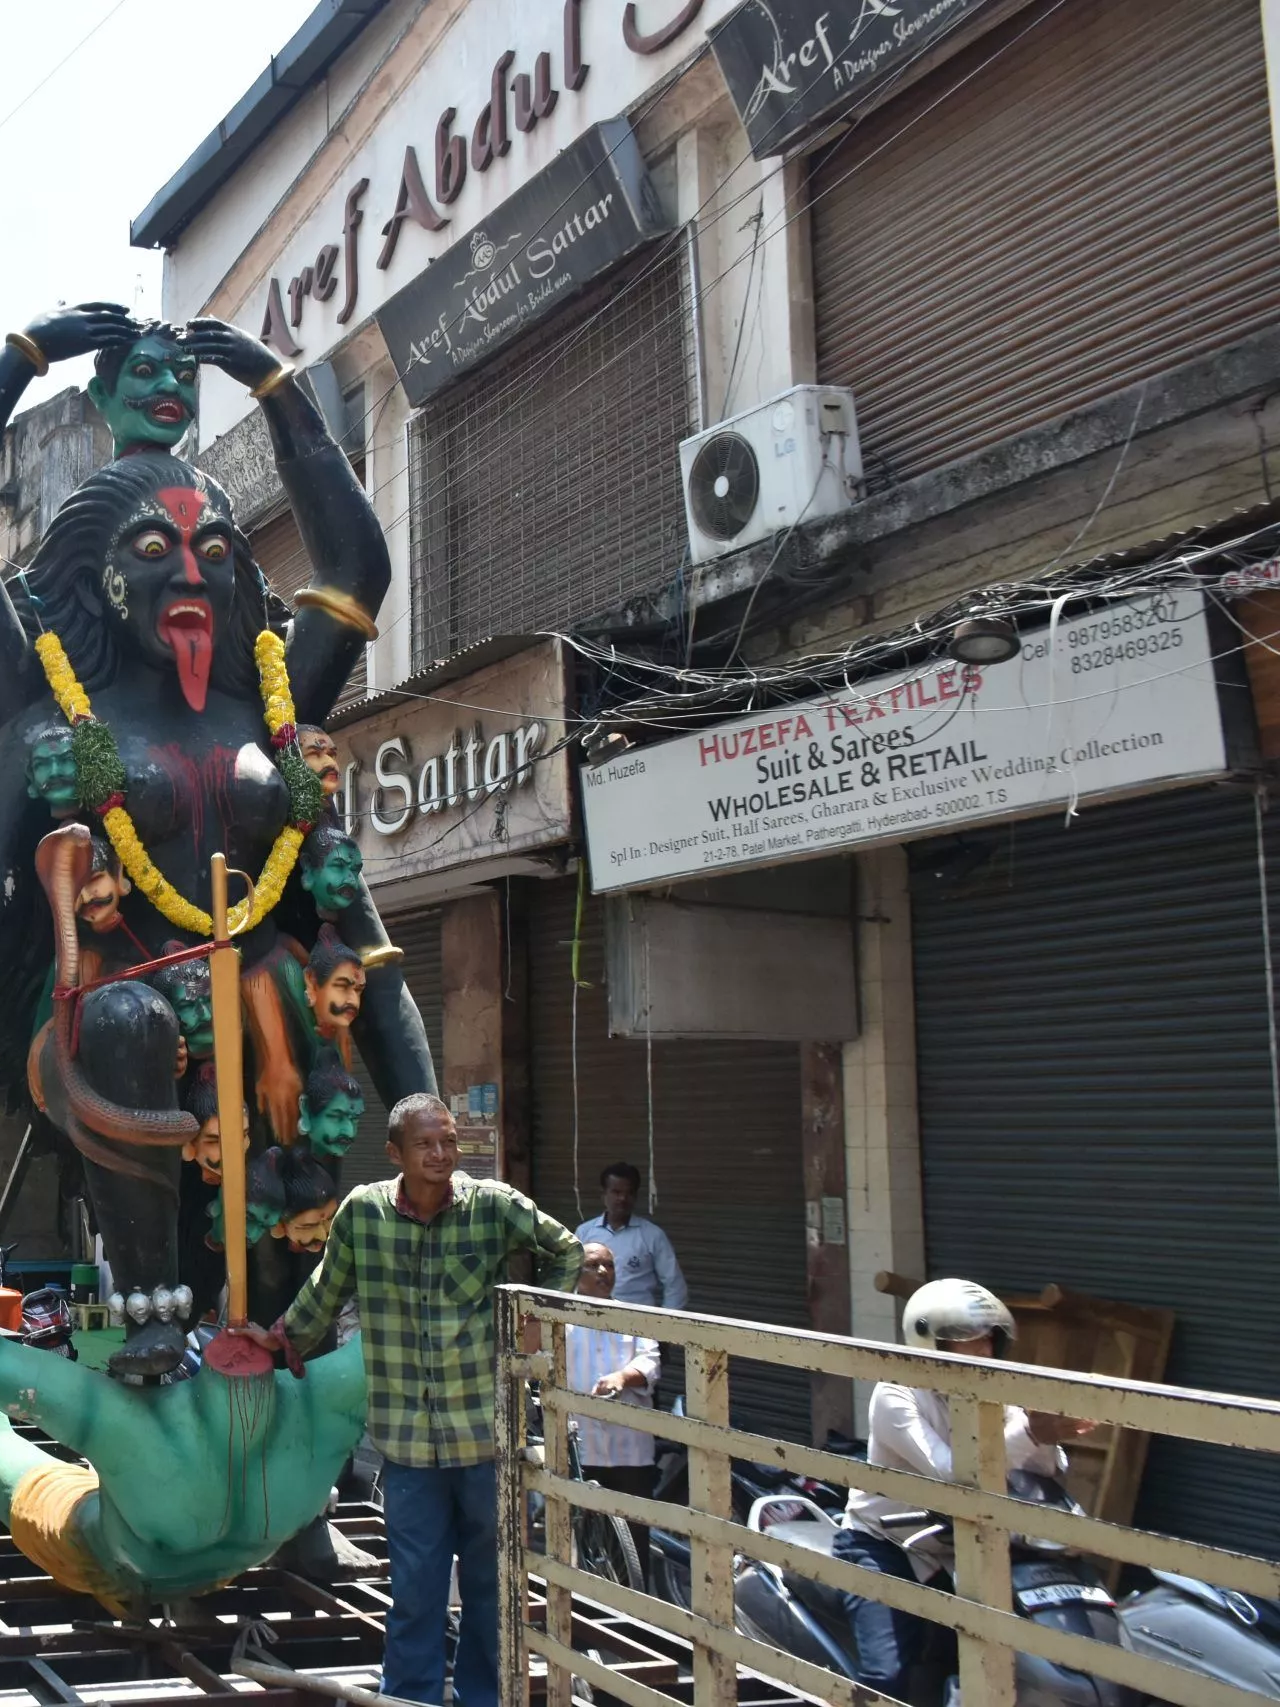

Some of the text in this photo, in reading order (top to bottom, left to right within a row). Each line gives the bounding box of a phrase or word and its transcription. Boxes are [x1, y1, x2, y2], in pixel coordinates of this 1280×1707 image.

[749, 12, 831, 113] Aref
[843, 40, 893, 82] Designer
[259, 0, 591, 357] Aref Abdul
[406, 193, 613, 375] Aref Abdul Sattar
[527, 278, 554, 310] Bridal
[775, 438, 796, 458] LG
[1071, 627, 1183, 674] 8328469325
[699, 664, 984, 767] HUZEFA TEXTILES
[371, 718, 545, 837] Sattar
[586, 759, 646, 788] Md. Huzefa
[708, 740, 988, 822] WHOLESALE & RETAIL
[756, 725, 915, 785] Suit & Sarees
[610, 847, 627, 866] Spl
[630, 846, 642, 859] In
[649, 836, 699, 854] Designer
[701, 827, 730, 844] Suit,
[732, 818, 759, 838] Half
[762, 810, 809, 831] Sarees,
[812, 796, 870, 820] Gharara
[873, 791, 888, 806] &
[892, 774, 968, 802] Exclusive
[972, 755, 1056, 784] Wedding
[1060, 730, 1164, 766] Collection
[742, 842, 766, 856] Patel
